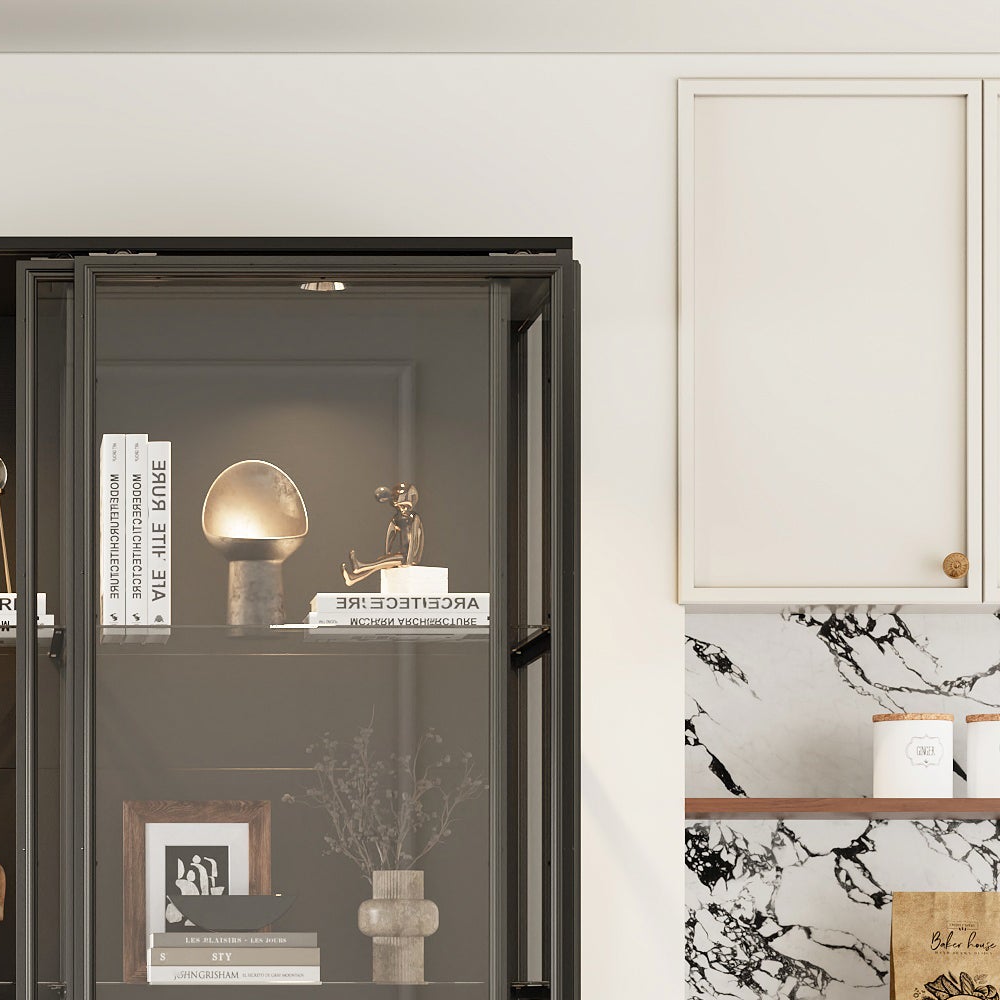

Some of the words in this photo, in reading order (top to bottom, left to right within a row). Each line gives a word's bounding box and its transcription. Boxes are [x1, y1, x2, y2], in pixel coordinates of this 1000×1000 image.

[916, 746, 936, 756] GINGER
[930, 930, 963, 951] Baker
[966, 931, 998, 952] house
